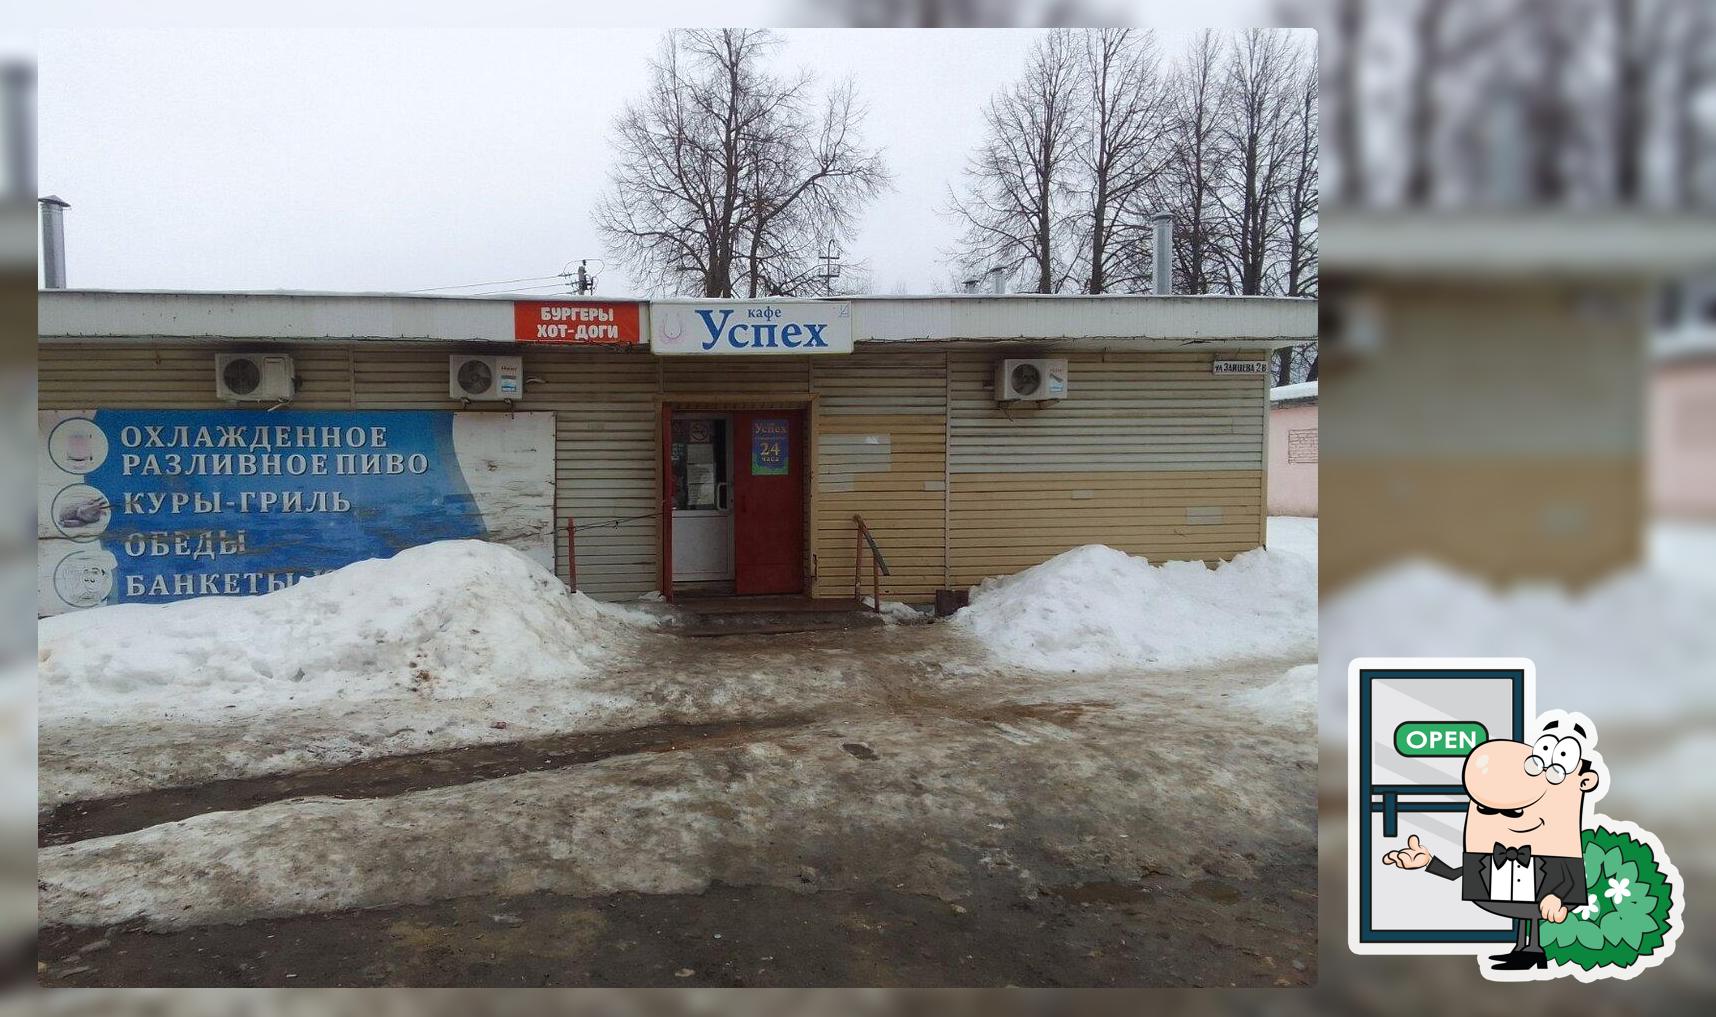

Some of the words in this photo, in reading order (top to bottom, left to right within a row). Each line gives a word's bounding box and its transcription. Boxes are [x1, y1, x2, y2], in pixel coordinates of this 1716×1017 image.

[540, 307, 614, 322] БУРГЕРЫ
[748, 306, 782, 320] кафе
[536, 324, 619, 340] ХОТ-ДОГИ
[695, 309, 829, 350] Успех
[120, 425, 388, 453] ОХЛАЖДЕННОЕ
[761, 442, 780, 456] 24
[121, 453, 329, 477] РАЗЛИВНОЕ
[335, 452, 429, 475] ПИВО
[123, 490, 352, 516] КУРЫ-ГРИЛЬ
[124, 531, 246, 560] ОБЕДЫ
